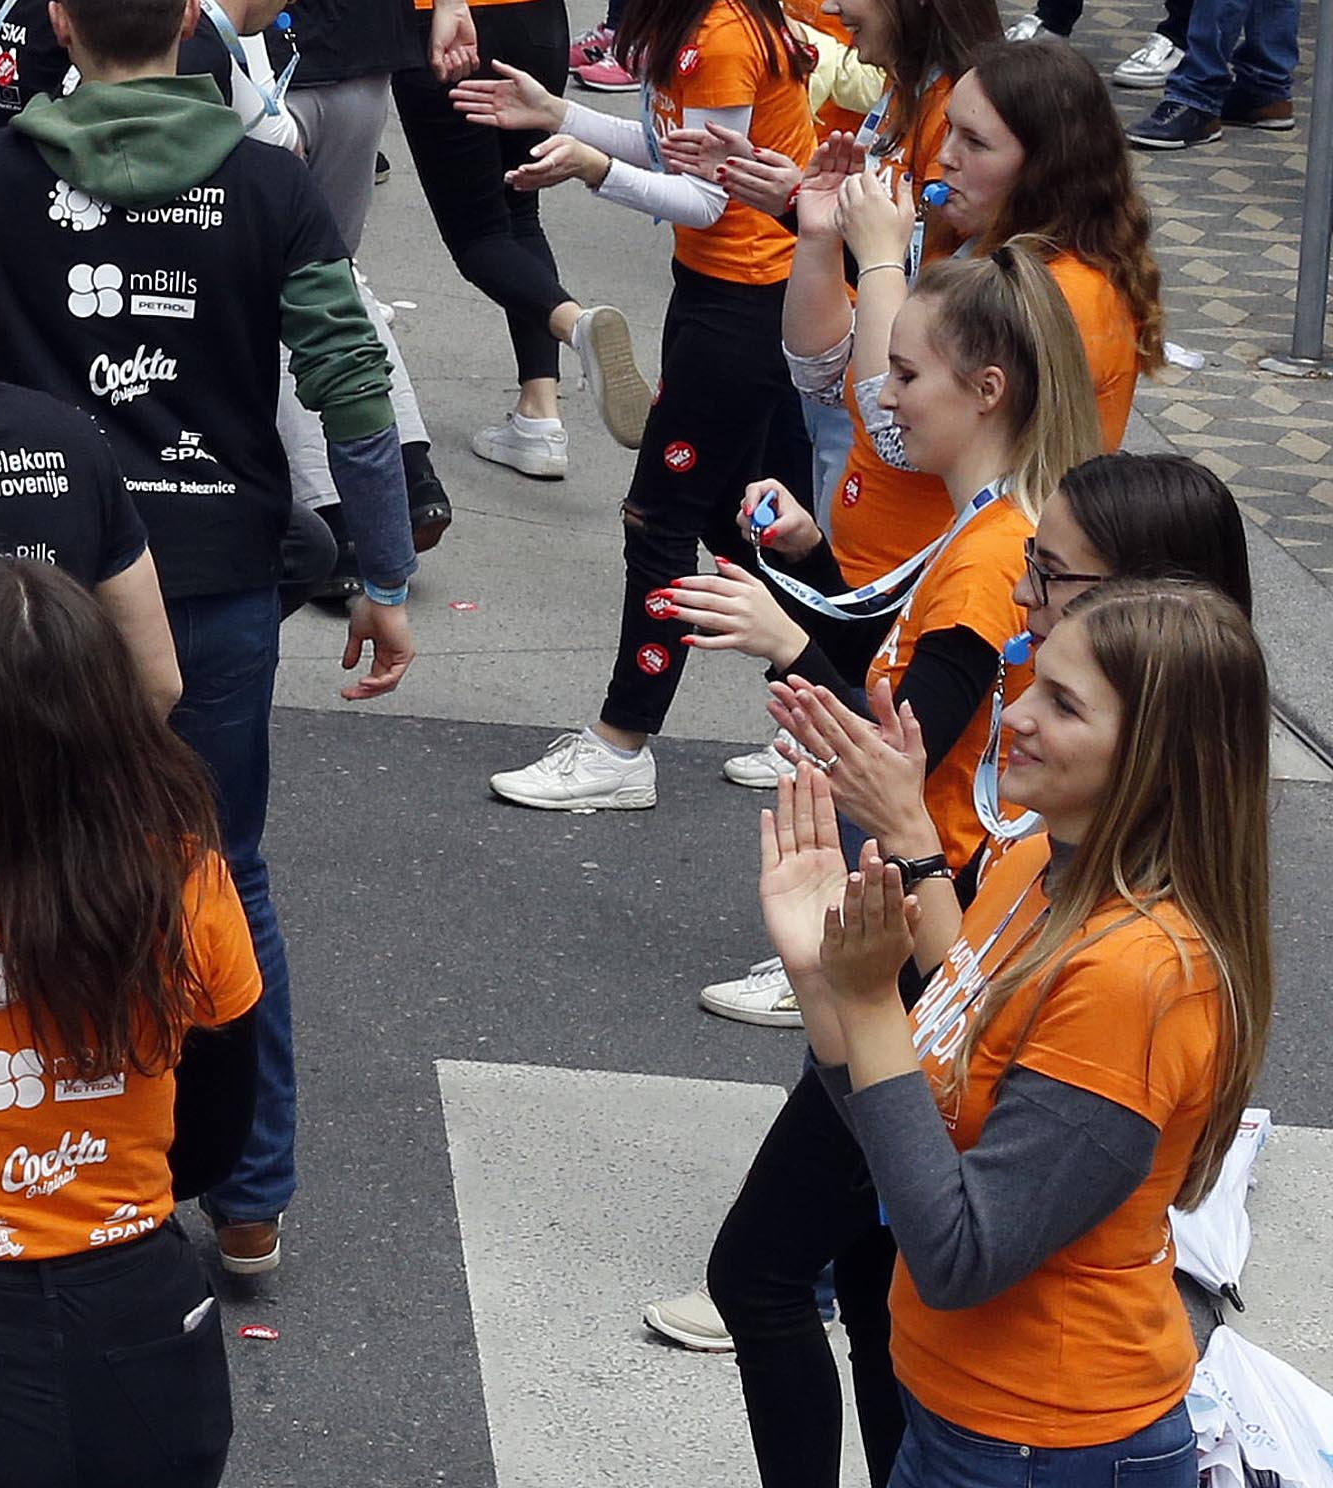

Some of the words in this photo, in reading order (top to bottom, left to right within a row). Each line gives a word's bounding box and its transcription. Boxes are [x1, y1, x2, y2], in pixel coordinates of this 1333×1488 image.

[126, 205, 224, 229] Slovenije
[130, 269, 198, 295] mBills
[138, 300, 190, 313] PETROL
[89, 343, 179, 397] Cockta
[111, 379, 150, 406] Original
[123, 475, 179, 494] ovenske
[180, 479, 237, 495] železnice
[63, 1079, 118, 1095] PETROL
[1, 1130, 109, 1193] Cockta
[26, 1166, 78, 1200] Original
